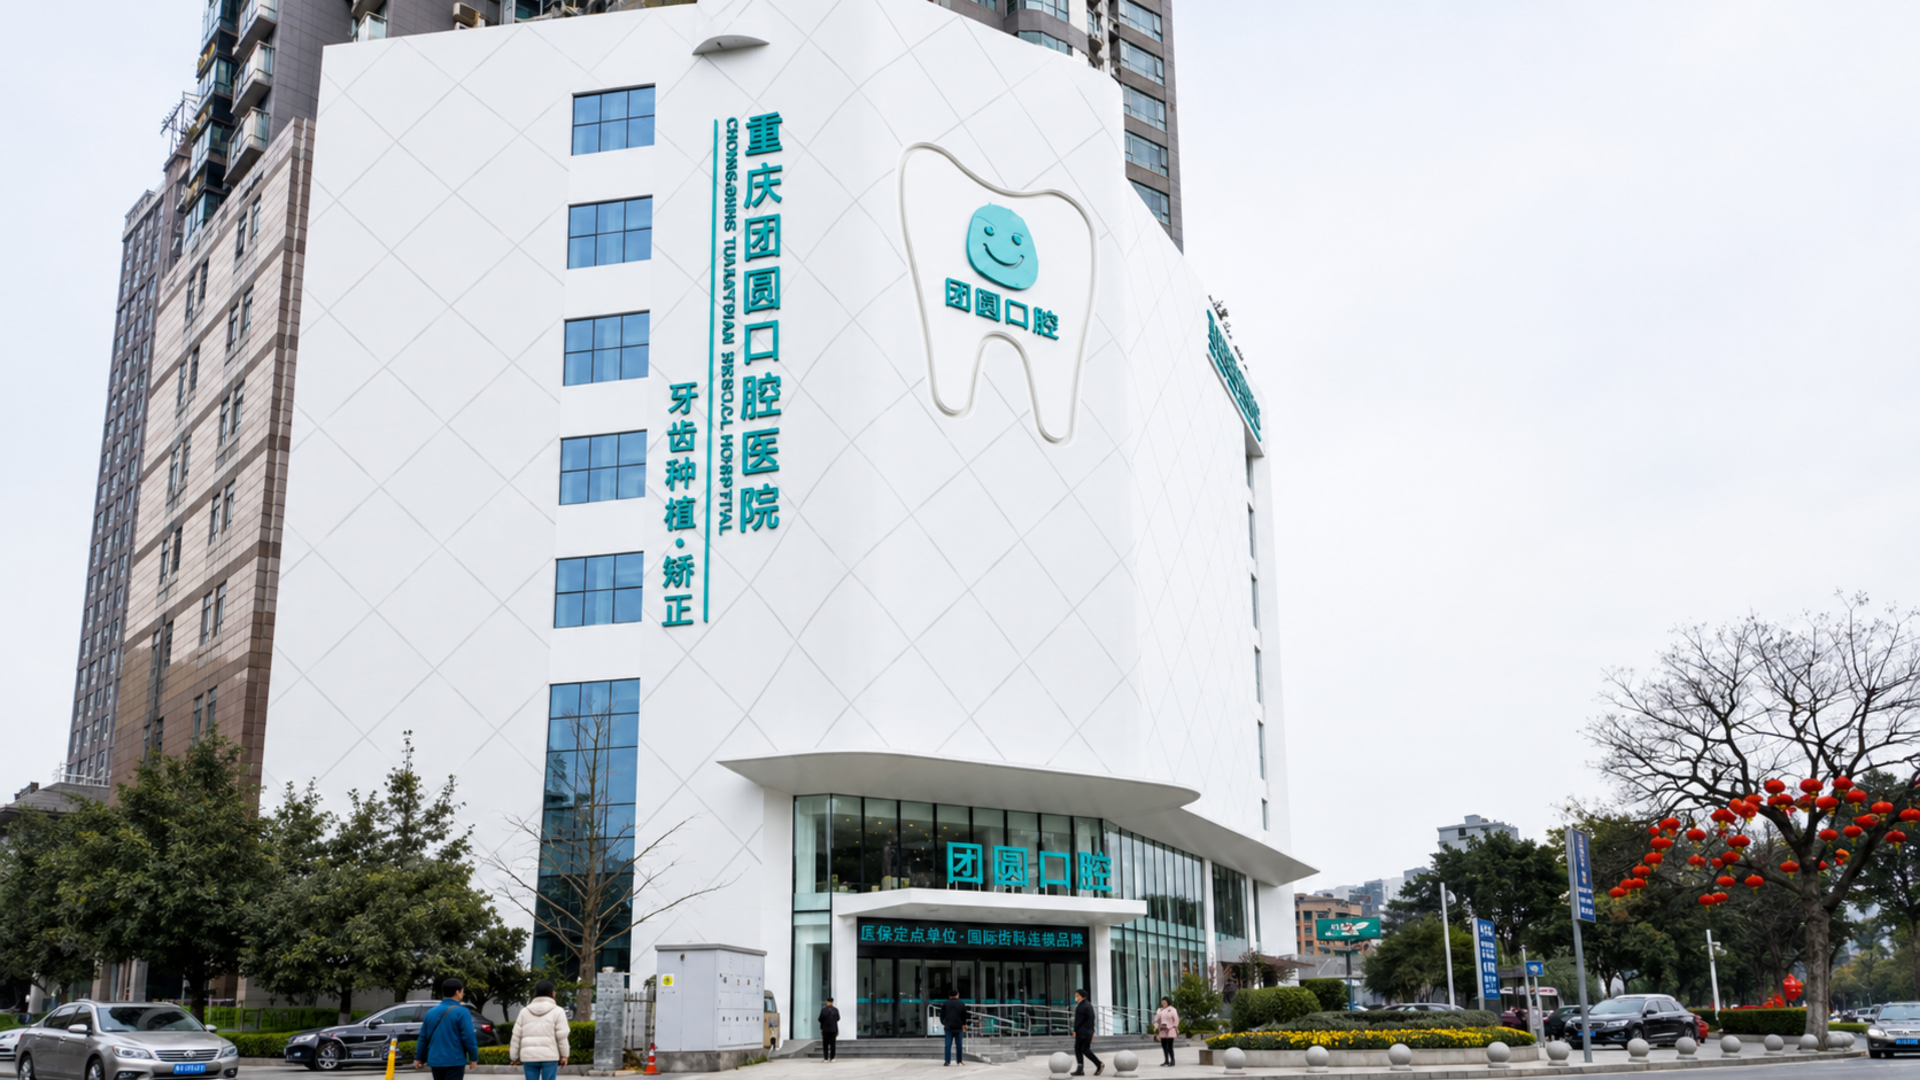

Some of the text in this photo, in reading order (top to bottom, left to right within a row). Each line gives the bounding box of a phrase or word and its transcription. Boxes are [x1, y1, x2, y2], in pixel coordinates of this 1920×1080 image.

[740, 111, 783, 534] 重庆团圆口腔医院
[945, 277, 1060, 341] 团圆口腔
[661, 381, 699, 627] 牙齿种植·矫正
[946, 841, 1113, 893] 团圆口腔
